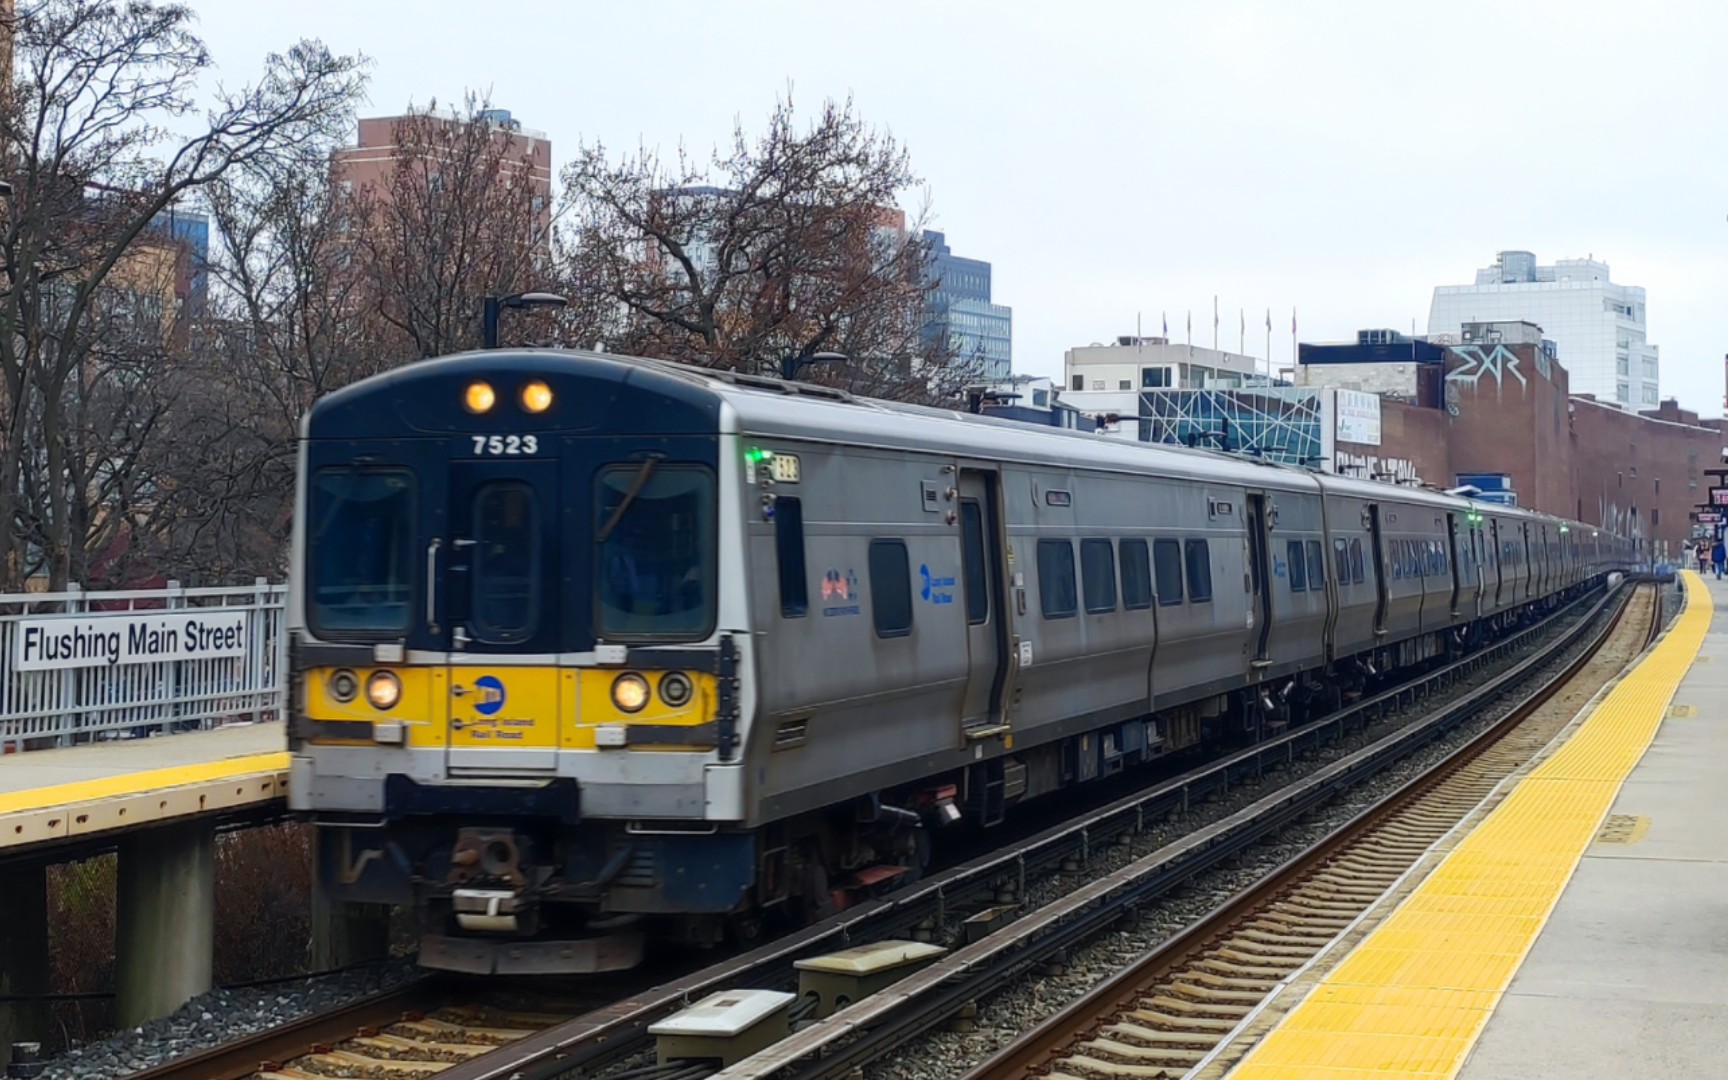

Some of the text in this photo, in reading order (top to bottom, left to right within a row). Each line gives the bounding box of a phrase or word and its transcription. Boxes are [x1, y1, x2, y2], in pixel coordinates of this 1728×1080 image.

[471, 434, 538, 455] 7523
[24, 619, 243, 664] Flushing Main Street
